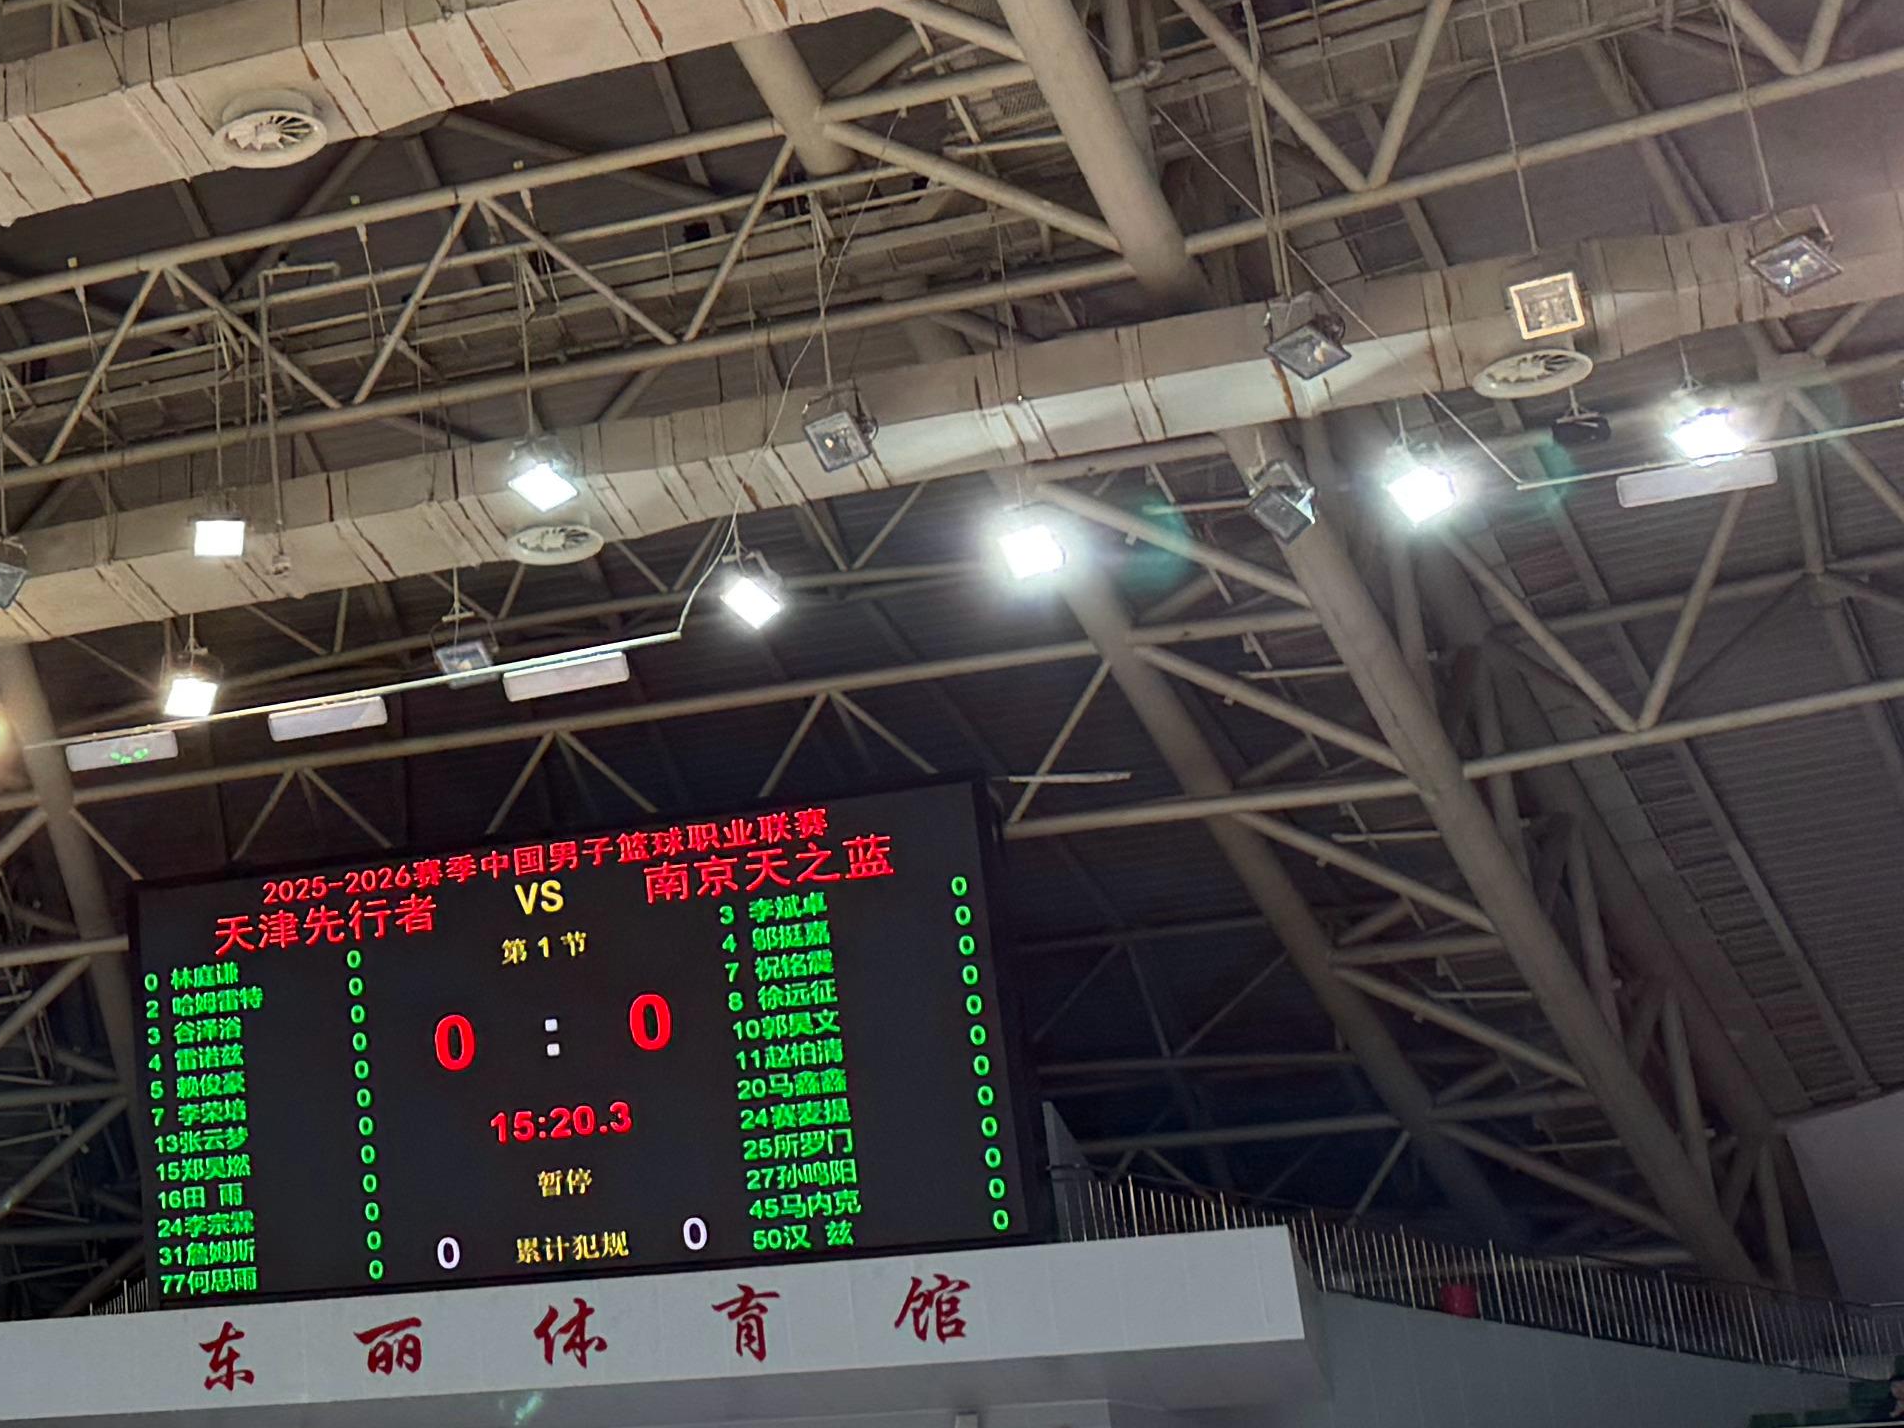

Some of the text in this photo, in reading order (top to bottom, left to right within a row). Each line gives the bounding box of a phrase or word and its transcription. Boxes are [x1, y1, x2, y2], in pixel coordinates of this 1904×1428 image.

[215, 833, 894, 957] 天津先行者 VS 南京天之蓝
[719, 905, 735, 925] 3
[950, 876, 968, 897] 0
[722, 934, 737, 953] 4
[954, 905, 971, 926] 0
[144, 973, 159, 991] 0
[346, 950, 362, 969] 0
[725, 962, 740, 982] 7
[958, 935, 975, 956] 0
[145, 1000, 160, 1019] 2
[349, 977, 364, 997] 0
[728, 991, 744, 1012] 8
[962, 964, 979, 985] 0
[965, 994, 983, 1015] 0
[147, 1027, 161, 1045] 3
[350, 1004, 366, 1024] 0
[434, 1014, 475, 1071] 0
[629, 994, 672, 1051] 0
[969, 1024, 987, 1046] 0
[148, 1053, 162, 1072] 4
[352, 1032, 368, 1052] 0
[973, 1054, 990, 1076] 0
[150, 1080, 164, 1100] 5
[354, 1060, 369, 1080] 0
[977, 1085, 994, 1106] 0
[151, 1108, 165, 1127] 7
[356, 1088, 372, 1108] 0
[490, 1101, 633, 1144] 15:20.3
[358, 1116, 374, 1136] 0
[981, 1116, 998, 1138] 0
[360, 1144, 376, 1165] 0
[984, 1147, 1002, 1169] 0
[362, 1173, 377, 1193] 0
[537, 1168, 592, 1197] 暂停
[988, 1178, 1006, 1199] 0
[364, 1202, 380, 1222] 0
[992, 1209, 1009, 1231] 0
[366, 1230, 382, 1251] 0
[437, 1217, 708, 1269] 0 累计犯规 0
[369, 1259, 384, 1280] 0
[200, 1273, 971, 1393] 东丽体育馆
